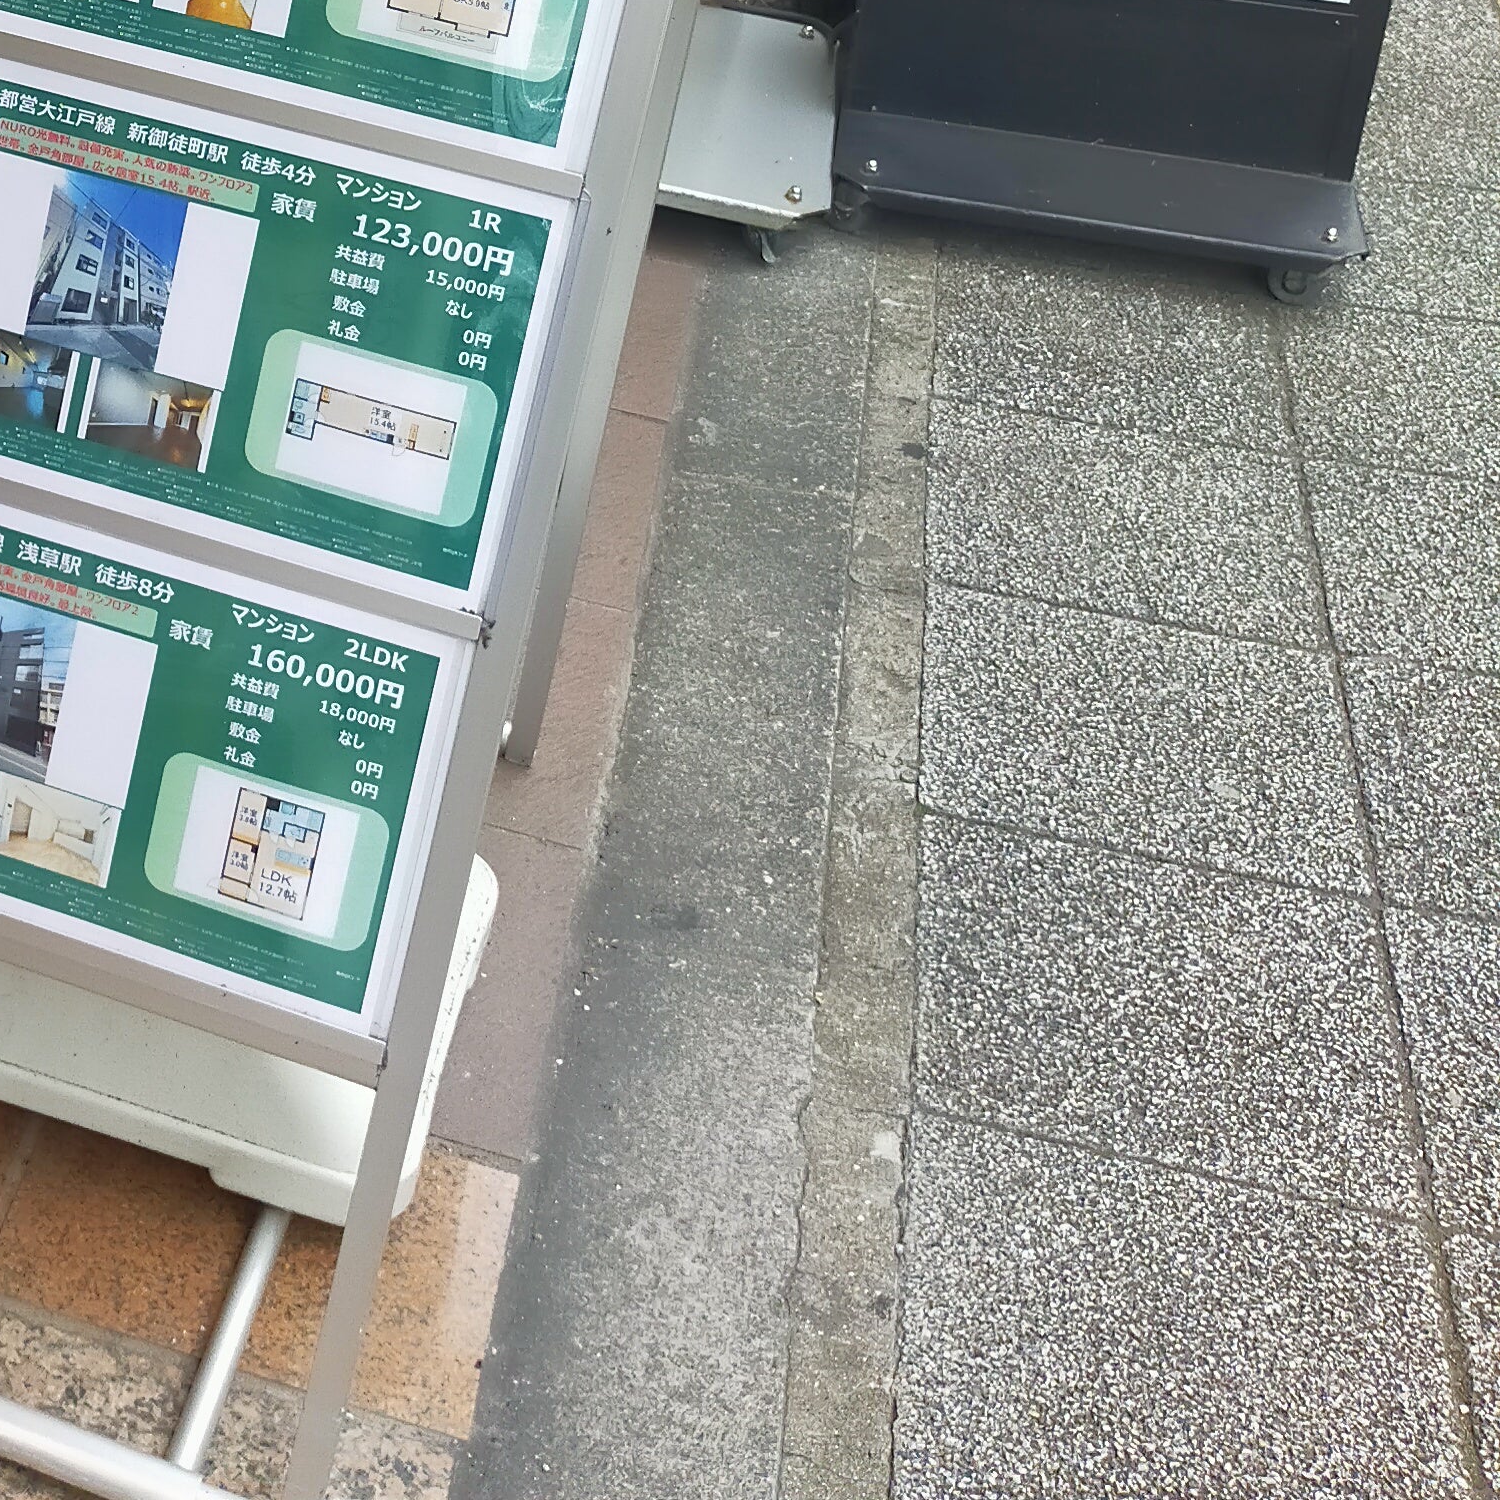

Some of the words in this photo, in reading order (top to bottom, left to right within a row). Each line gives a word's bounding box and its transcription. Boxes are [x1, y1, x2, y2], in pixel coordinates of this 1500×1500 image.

[125, 121, 229, 164] 新御徒町駅
[239, 149, 317, 186] 徒歩4分
[335, 172, 422, 211] マンション
[467, 208, 502, 234] 1R
[269, 191, 317, 223] 家賃
[351, 213, 515, 277] 123,000円
[333, 242, 385, 271] 共益費
[424, 268, 506, 302] 15,000円
[326, 318, 361, 342] 礼金
[457, 350, 487, 371] 0円
[15, 538, 82, 576] 浅草駅
[93, 562, 175, 604] 徒歩8分
[231, 602, 315, 643] マンション
[342, 637, 409, 673] 2LDK
[167, 618, 214, 650] 家賃
[246, 642, 405, 710] 160,000円
[229, 671, 280, 700] 共益費
[318, 699, 396, 734] 18,000円
[222, 744, 256, 768] 礼金
[349, 779, 379, 800] 0円
